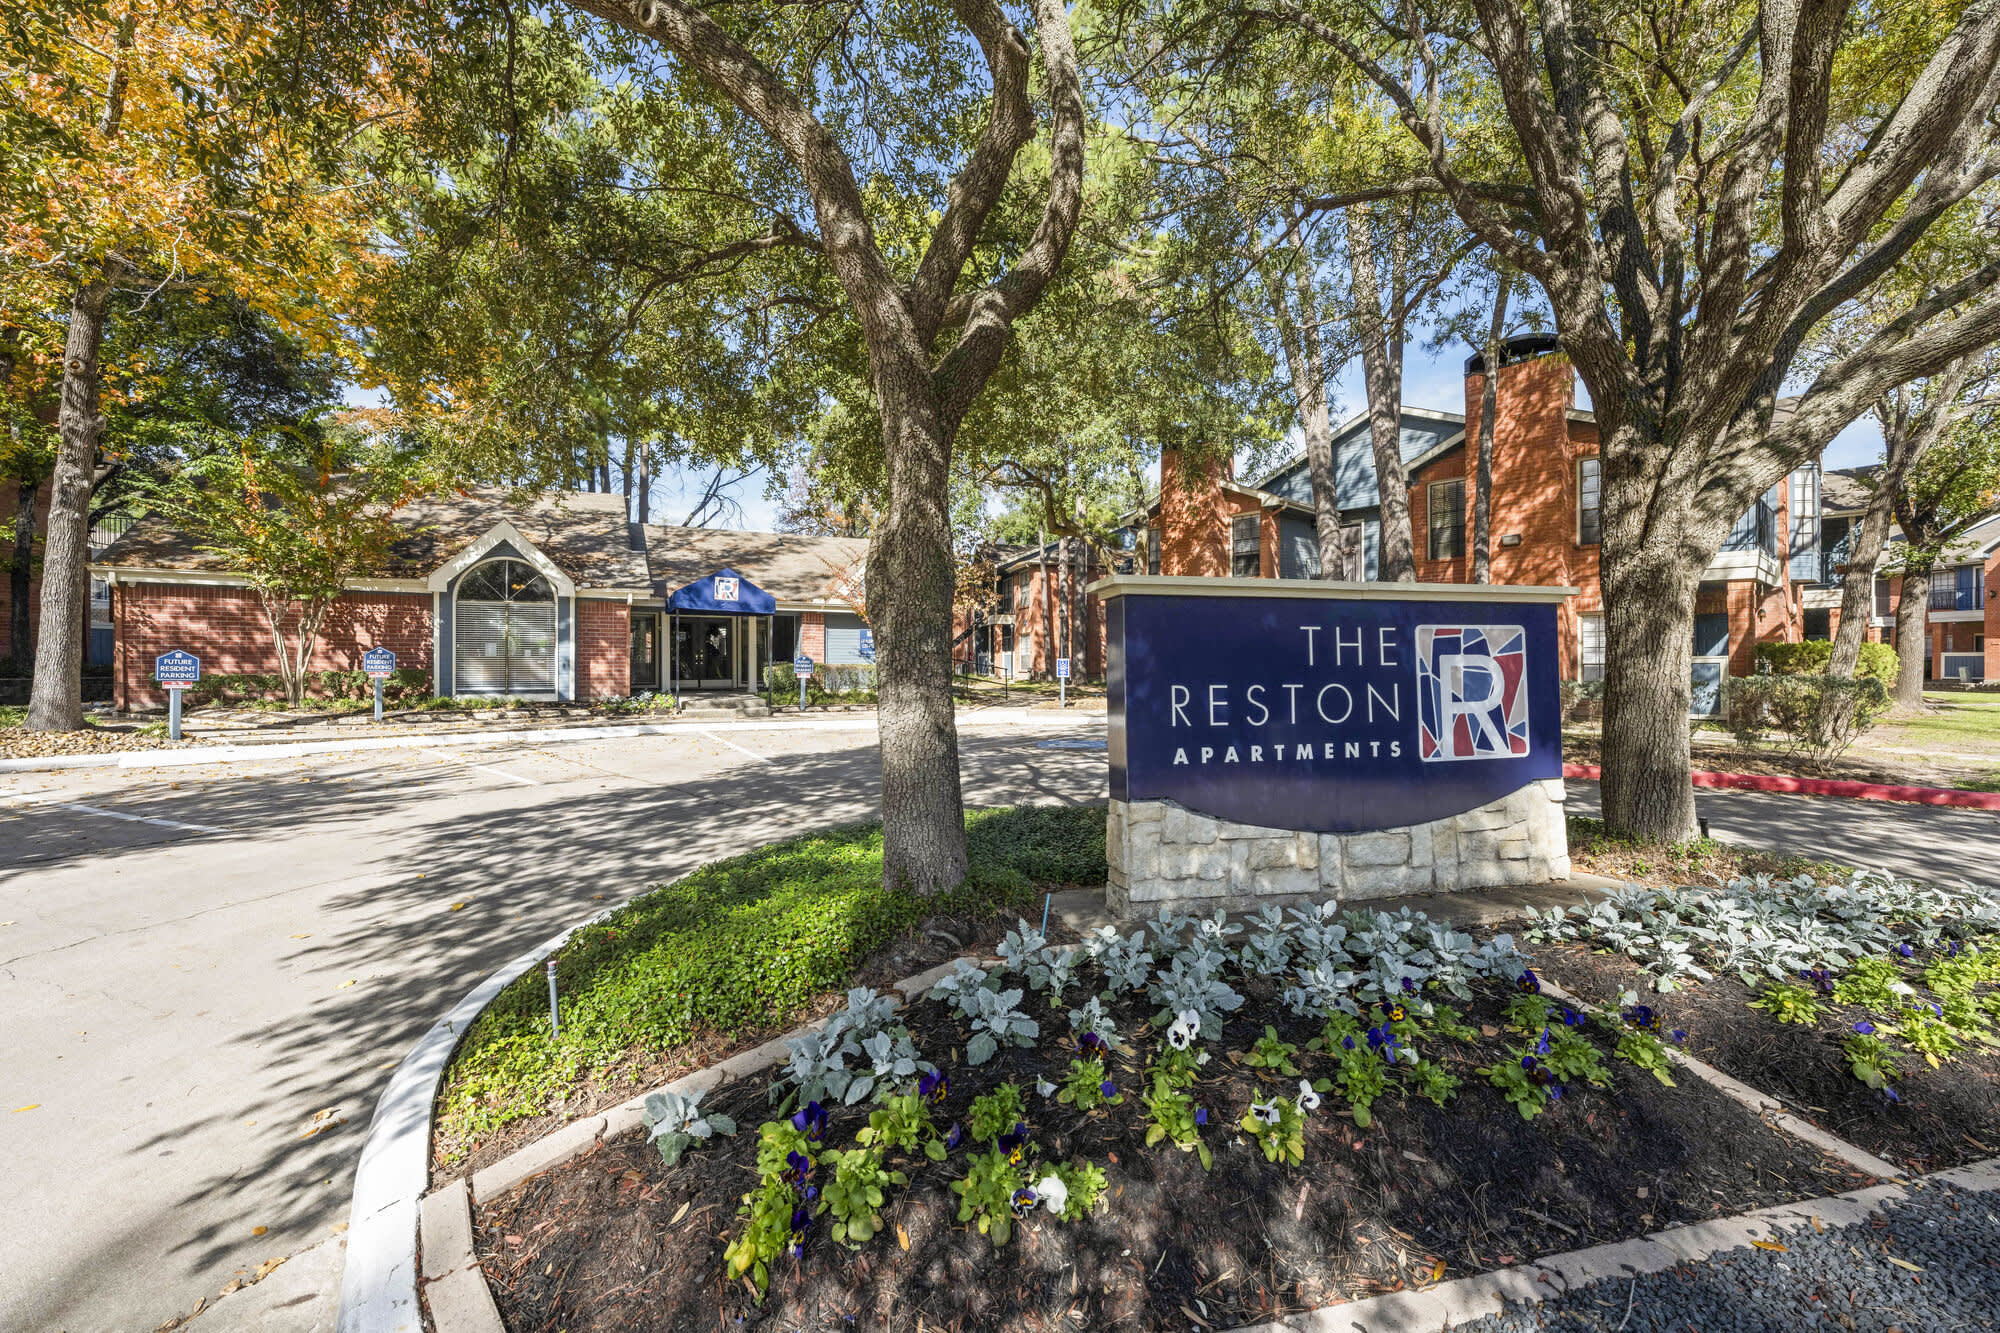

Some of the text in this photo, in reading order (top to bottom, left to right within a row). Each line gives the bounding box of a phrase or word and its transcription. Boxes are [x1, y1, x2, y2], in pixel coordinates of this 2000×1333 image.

[1300, 626, 1398, 666] THE
[1171, 683, 1401, 727] RESTON
[1439, 654, 1509, 758] R
[1173, 740, 1401, 765] APARTMENTS
